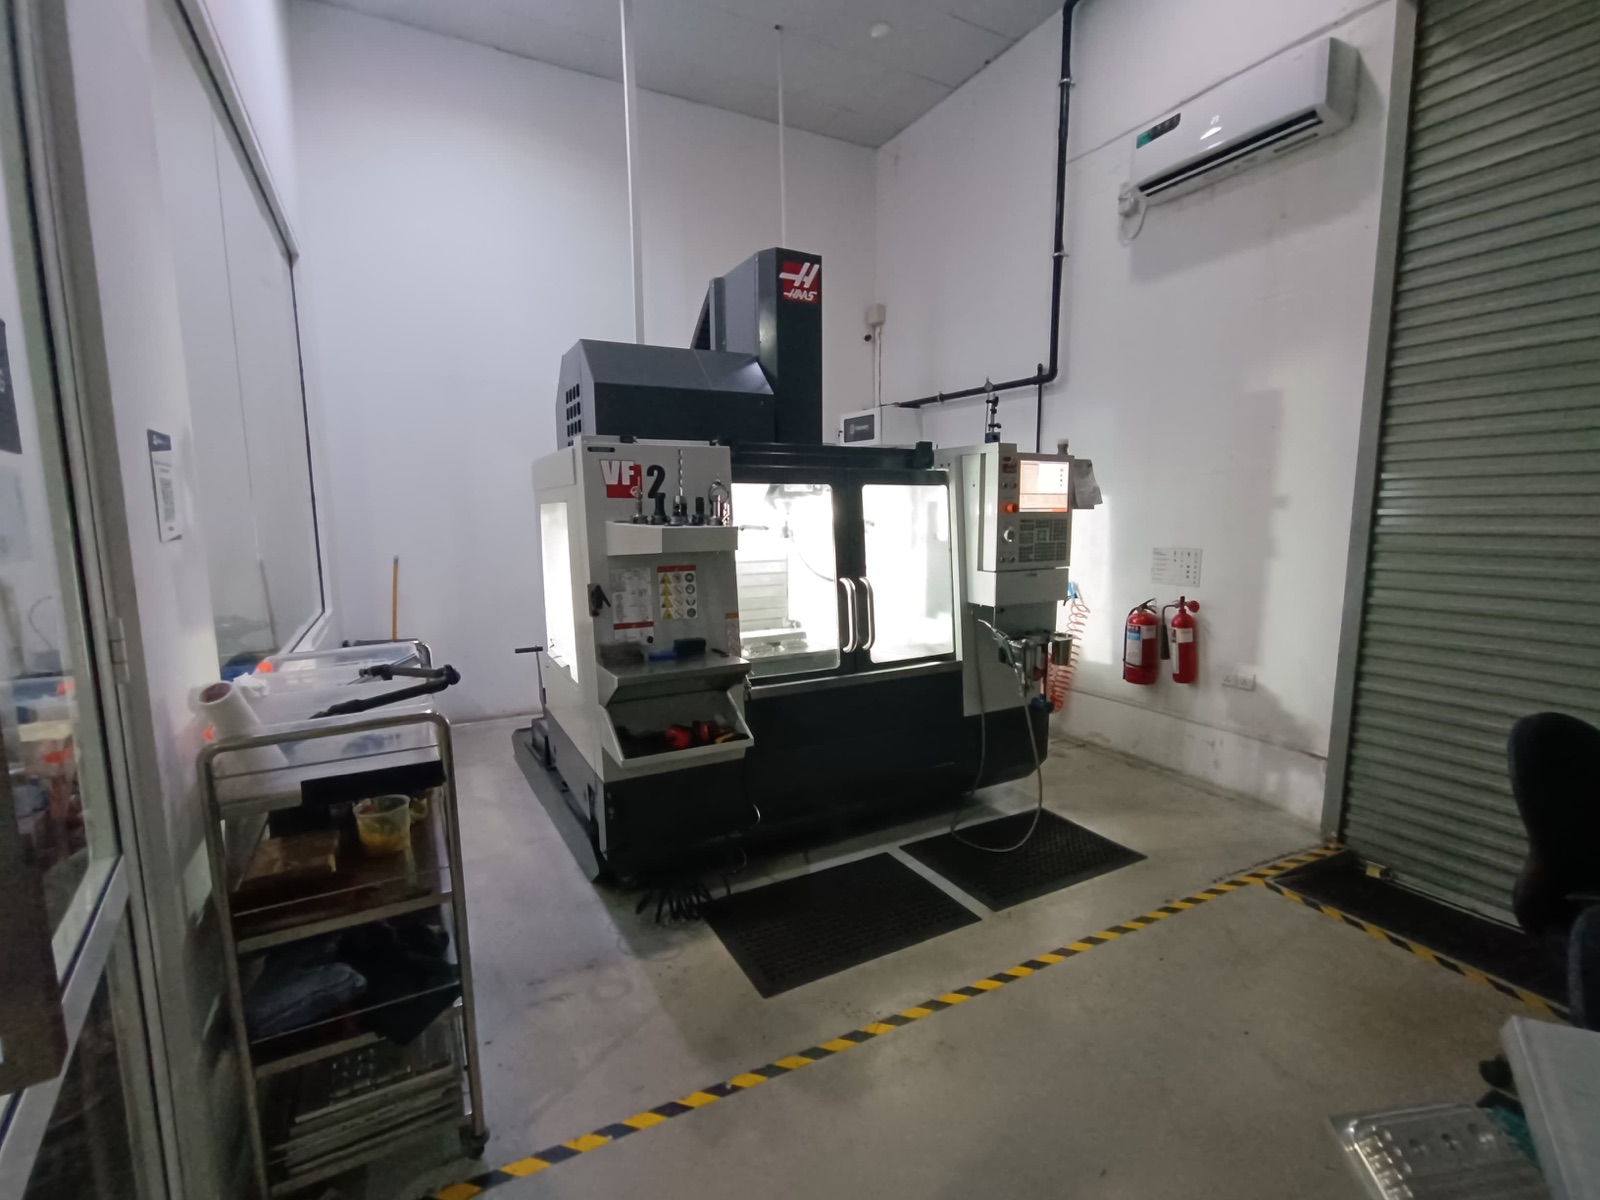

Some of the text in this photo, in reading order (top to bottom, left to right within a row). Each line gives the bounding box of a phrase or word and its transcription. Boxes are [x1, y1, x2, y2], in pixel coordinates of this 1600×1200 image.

[783, 288, 818, 301] HAAS
[600, 460, 666, 499] VF 2
